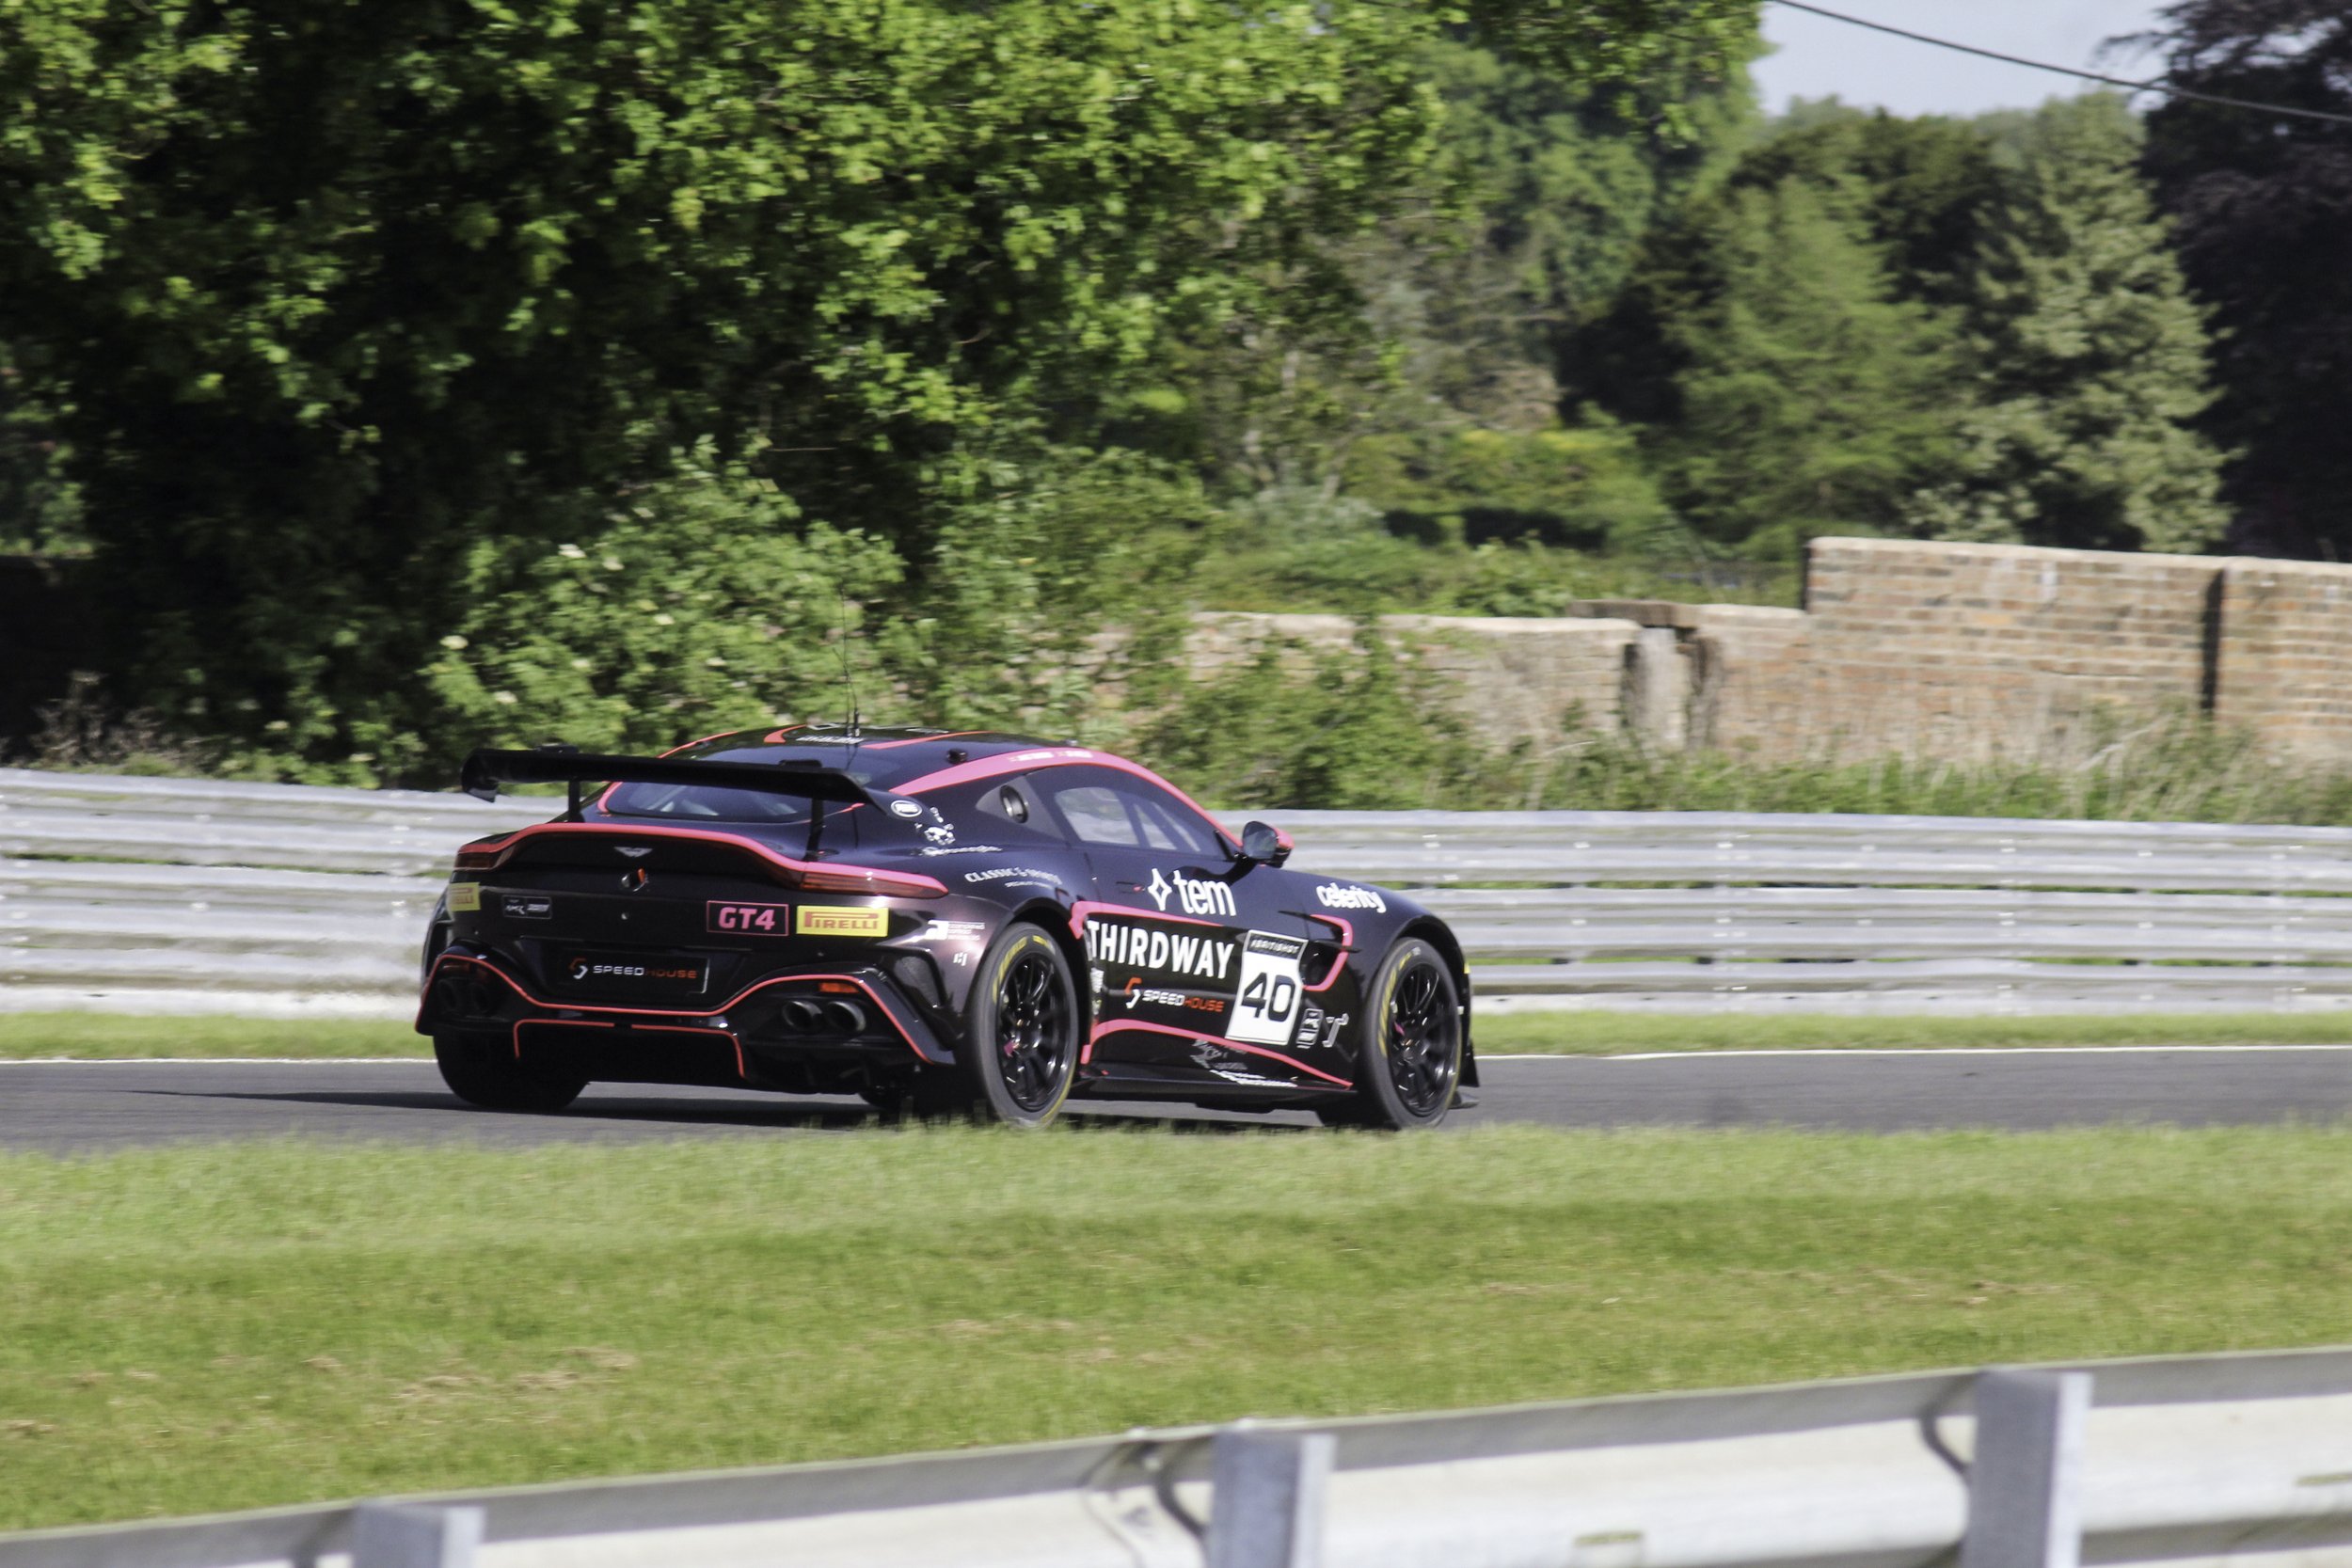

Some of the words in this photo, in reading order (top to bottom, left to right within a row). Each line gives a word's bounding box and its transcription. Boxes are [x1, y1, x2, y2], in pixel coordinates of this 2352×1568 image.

[1172, 869, 1237, 916] tem
[1315, 882, 1387, 913] celerity
[718, 907, 775, 930] GT4
[804, 911, 880, 929] PIRELLI
[1087, 920, 1235, 979] THIRDWAY
[1240, 972, 1296, 1022] 40
